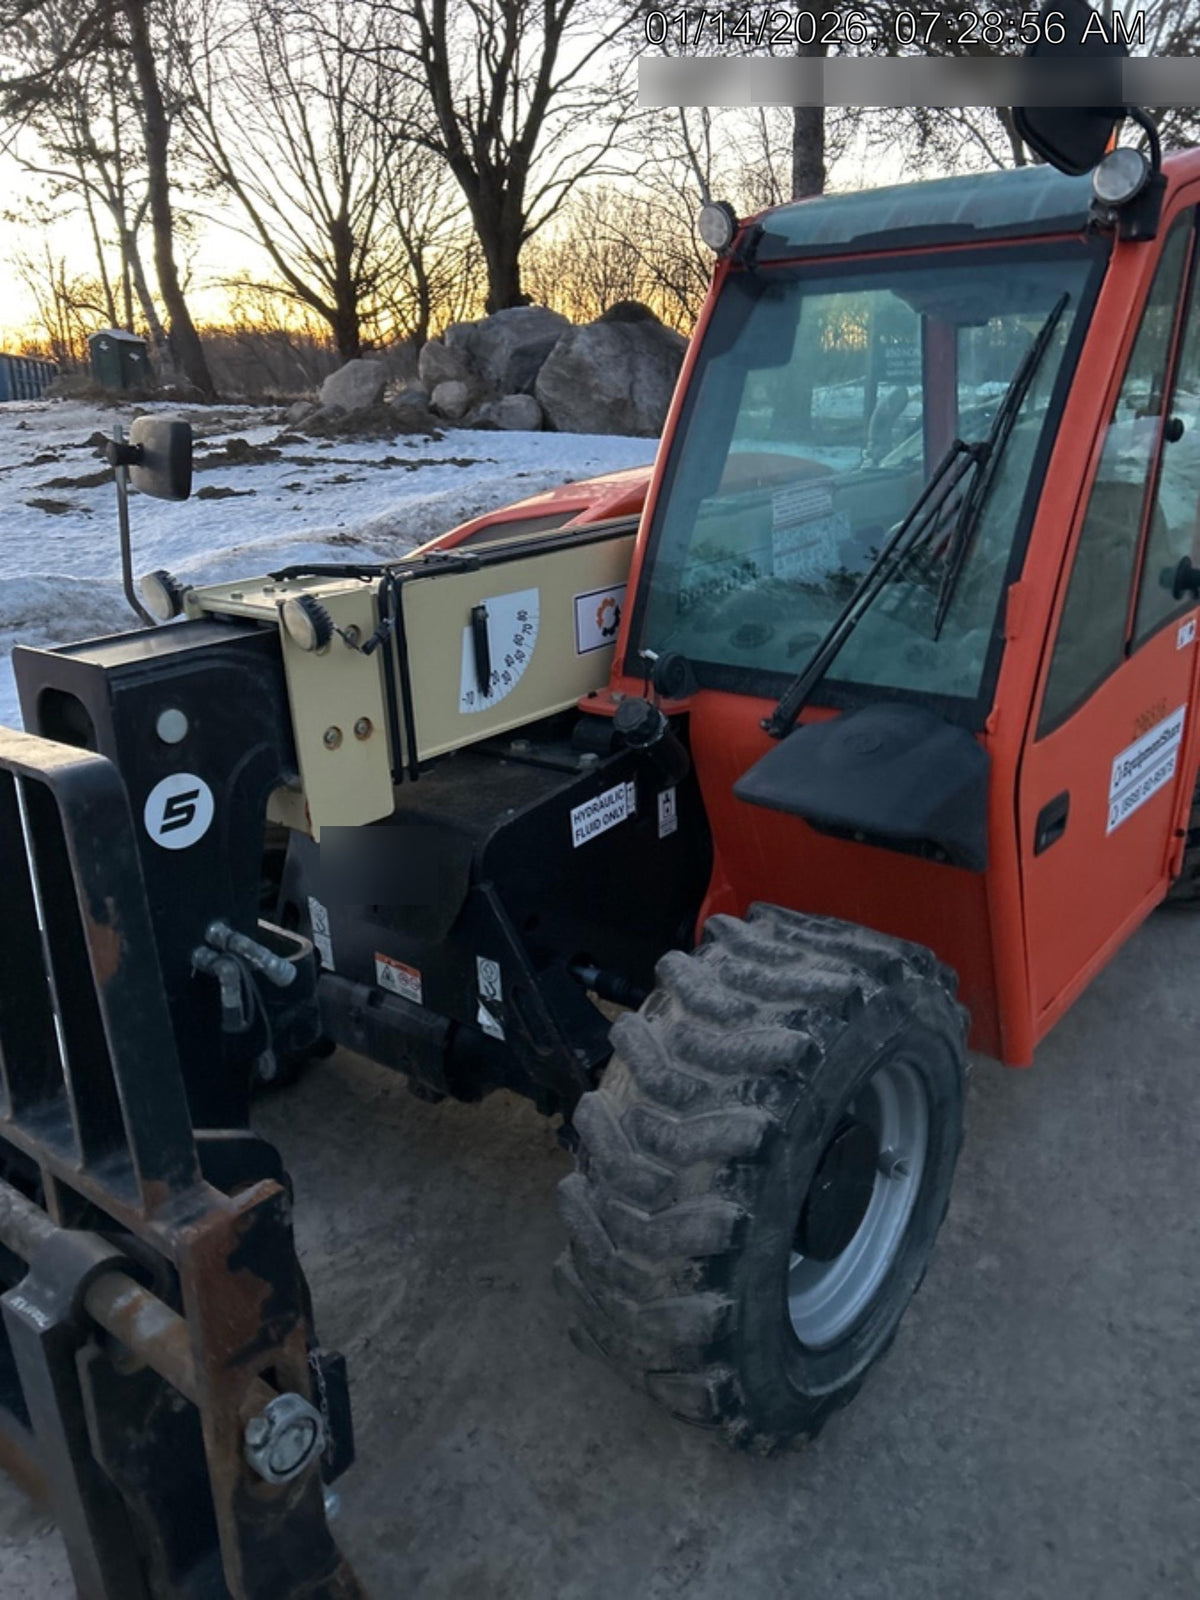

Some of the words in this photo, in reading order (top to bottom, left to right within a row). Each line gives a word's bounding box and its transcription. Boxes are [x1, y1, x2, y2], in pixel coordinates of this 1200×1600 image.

[522, 623, 533, 635] 70
[513, 634, 525, 646] 60
[514, 649, 526, 663] 50
[574, 788, 625, 825] HYDRAULIC
[575, 819, 602, 842] FLUID
[602, 804, 625, 825] ONLY
